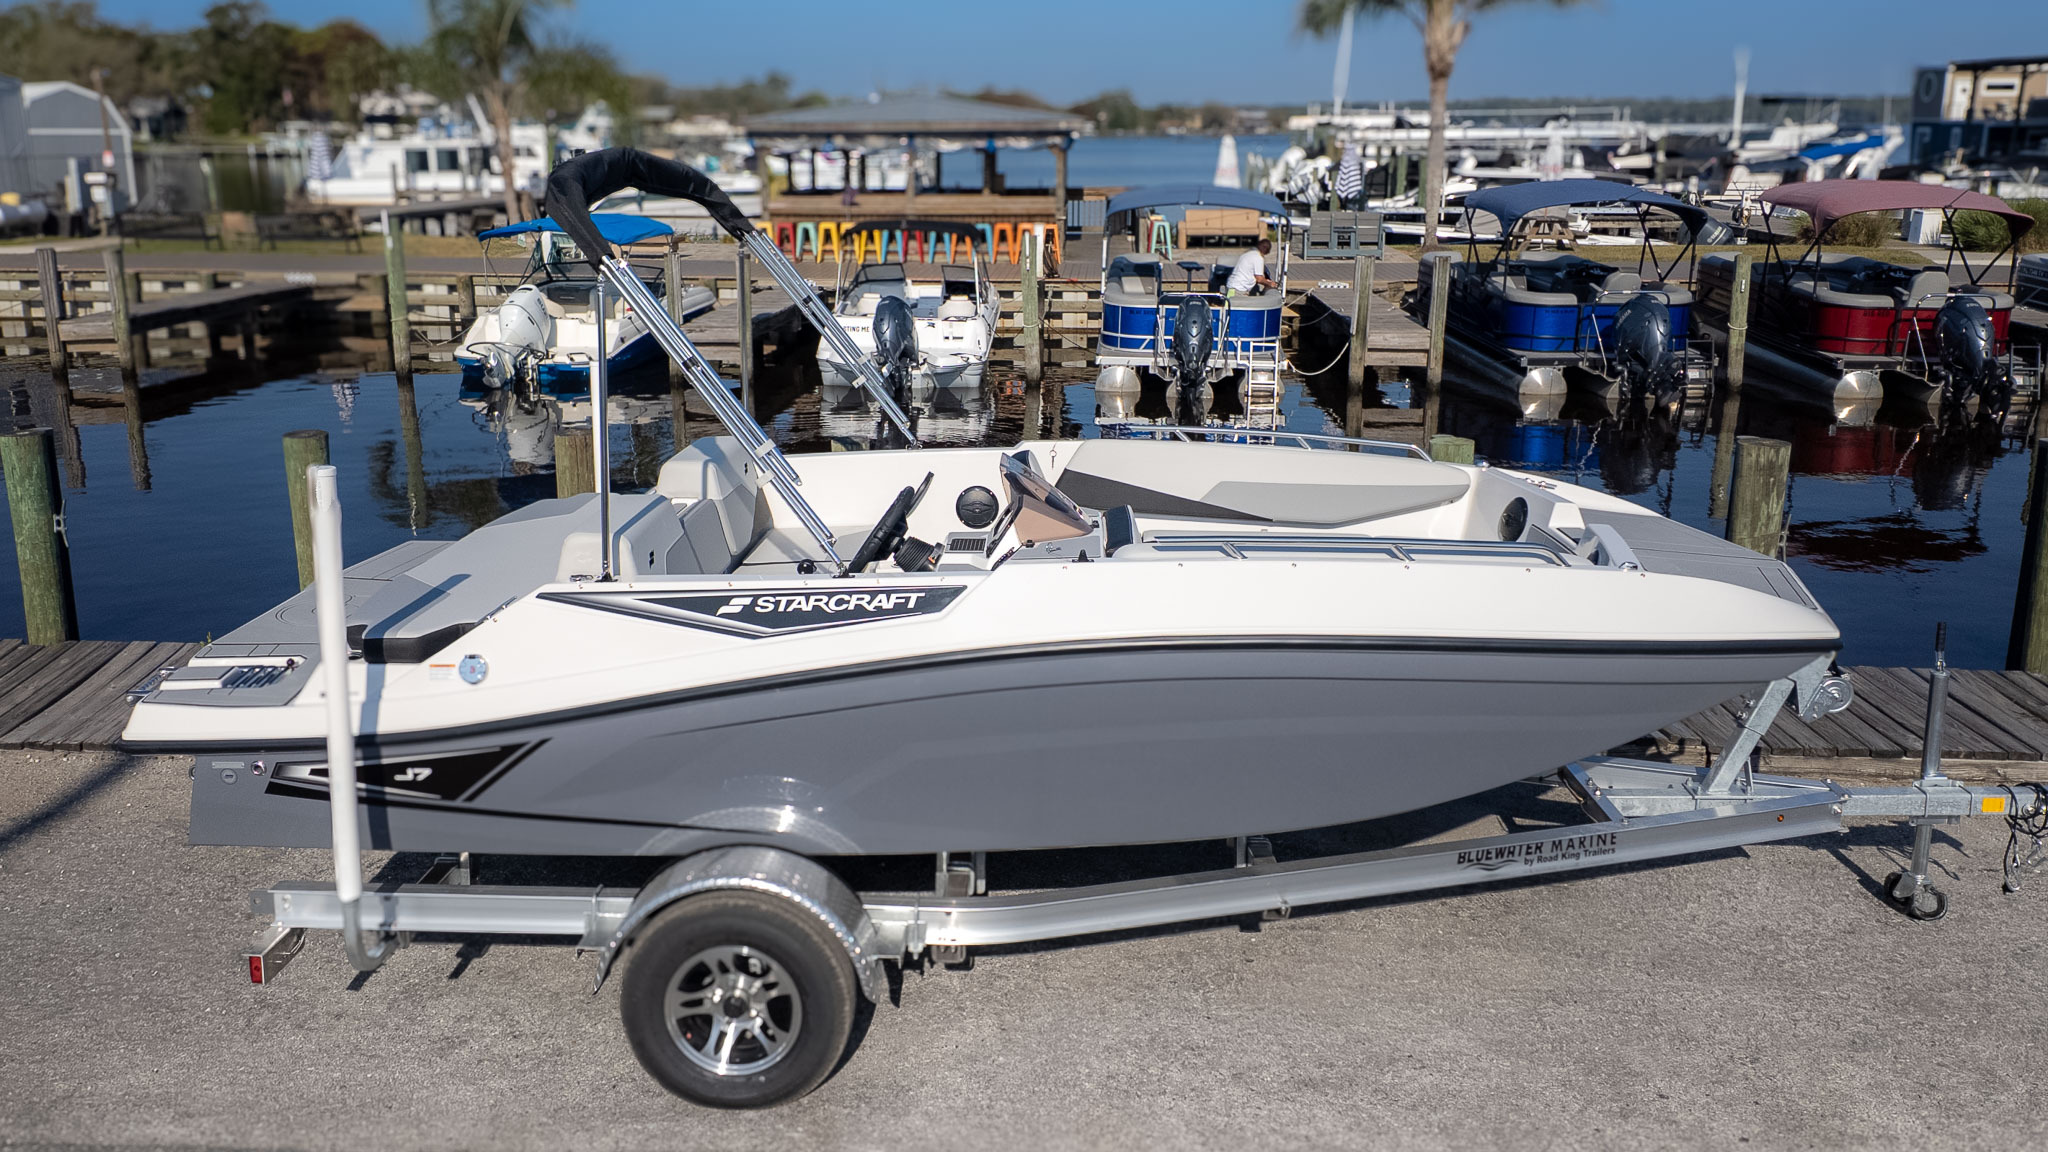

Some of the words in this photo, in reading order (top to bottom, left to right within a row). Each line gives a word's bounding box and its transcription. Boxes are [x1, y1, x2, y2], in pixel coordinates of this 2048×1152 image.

[754, 592, 926, 614] STARCRAFT
[1457, 842, 1545, 865] BLUEWATER
[1551, 832, 1617, 853] MARINE
[1524, 857, 1536, 867] by
[1537, 853, 1559, 864] Road
[1561, 851, 1581, 862] King
[1583, 846, 1617, 858] Trailers
